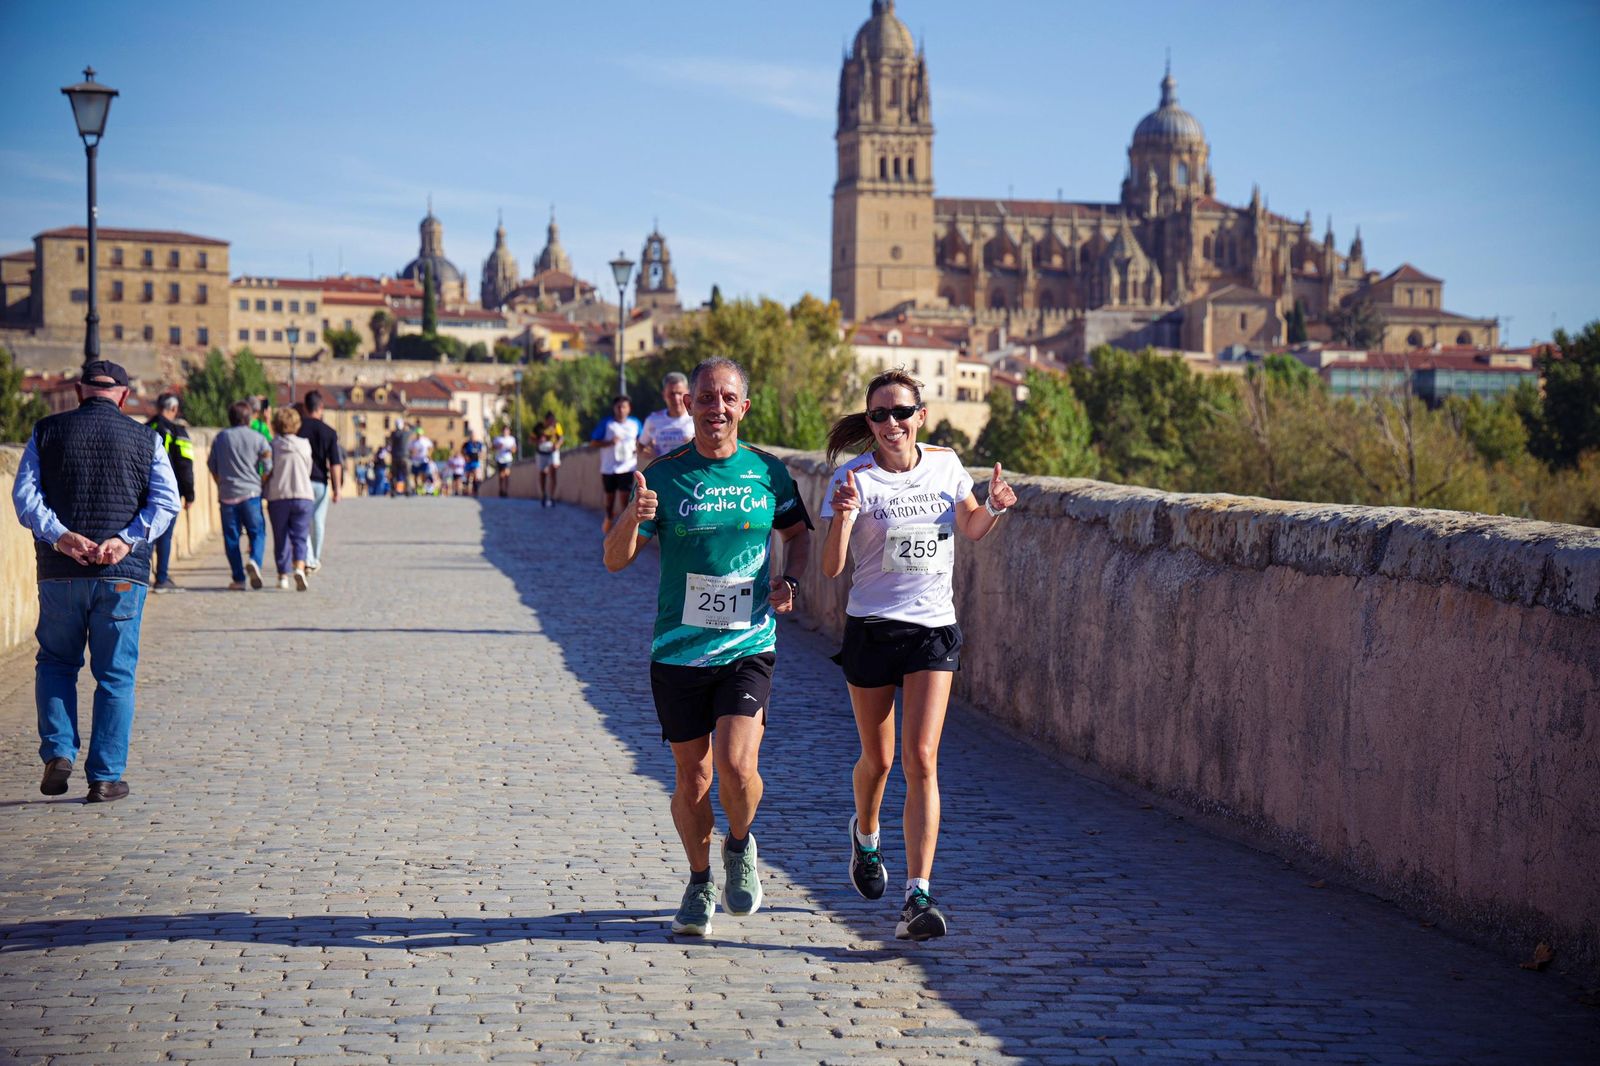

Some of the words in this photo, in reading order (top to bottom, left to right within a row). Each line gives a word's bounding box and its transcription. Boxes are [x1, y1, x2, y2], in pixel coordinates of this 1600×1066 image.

[693, 481, 752, 499] Carrera
[901, 492, 943, 504] CARRERA
[678, 497, 737, 517] Guardia
[740, 494, 768, 513] Civil
[873, 504, 927, 520] GVARDIA
[899, 540, 938, 558] 259
[698, 592, 738, 613] 251
